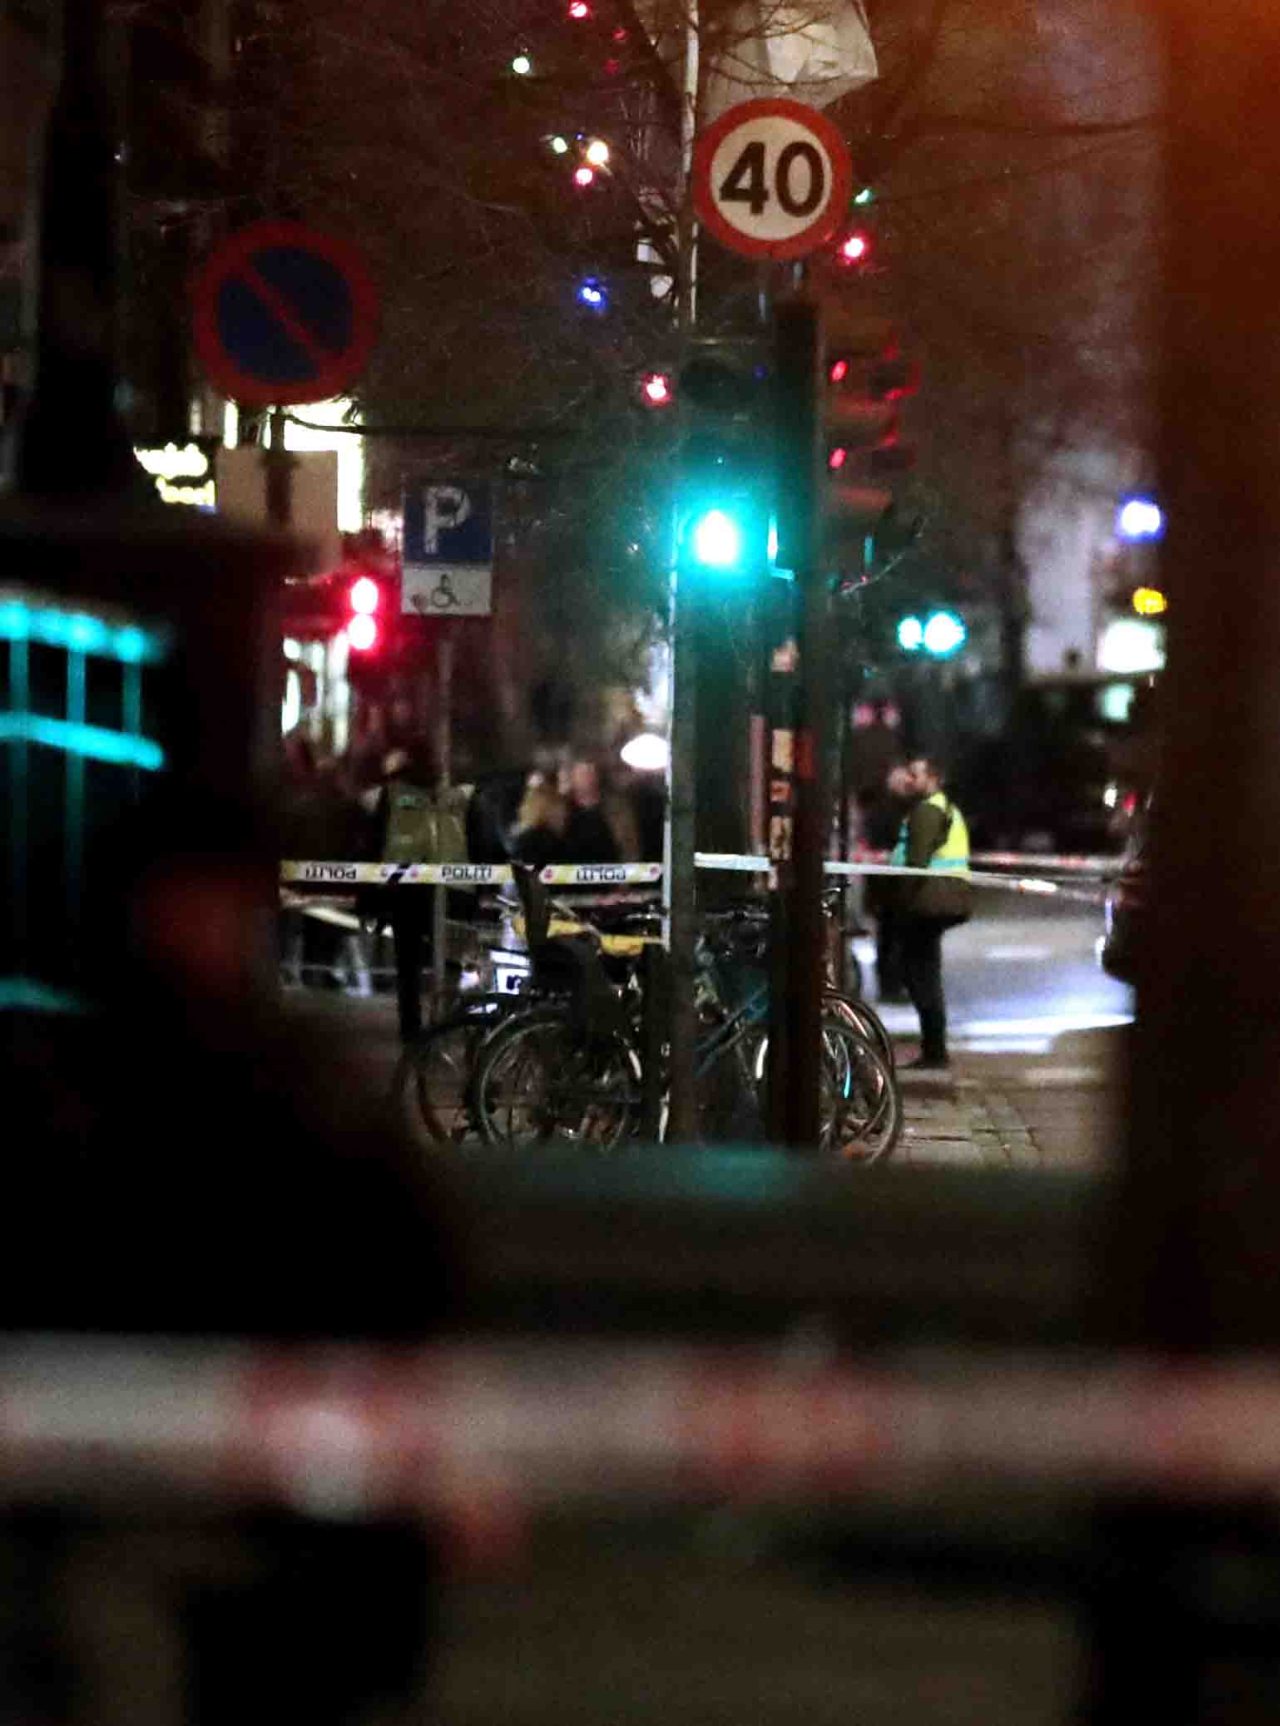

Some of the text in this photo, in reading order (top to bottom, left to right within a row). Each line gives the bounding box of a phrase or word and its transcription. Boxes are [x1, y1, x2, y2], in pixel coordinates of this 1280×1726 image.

[719, 140, 825, 218] 40
[425, 485, 470, 555] P
[305, 867, 357, 880] POLITI
[442, 866, 492, 880] POLITI
[576, 867, 626, 880] POLITI
